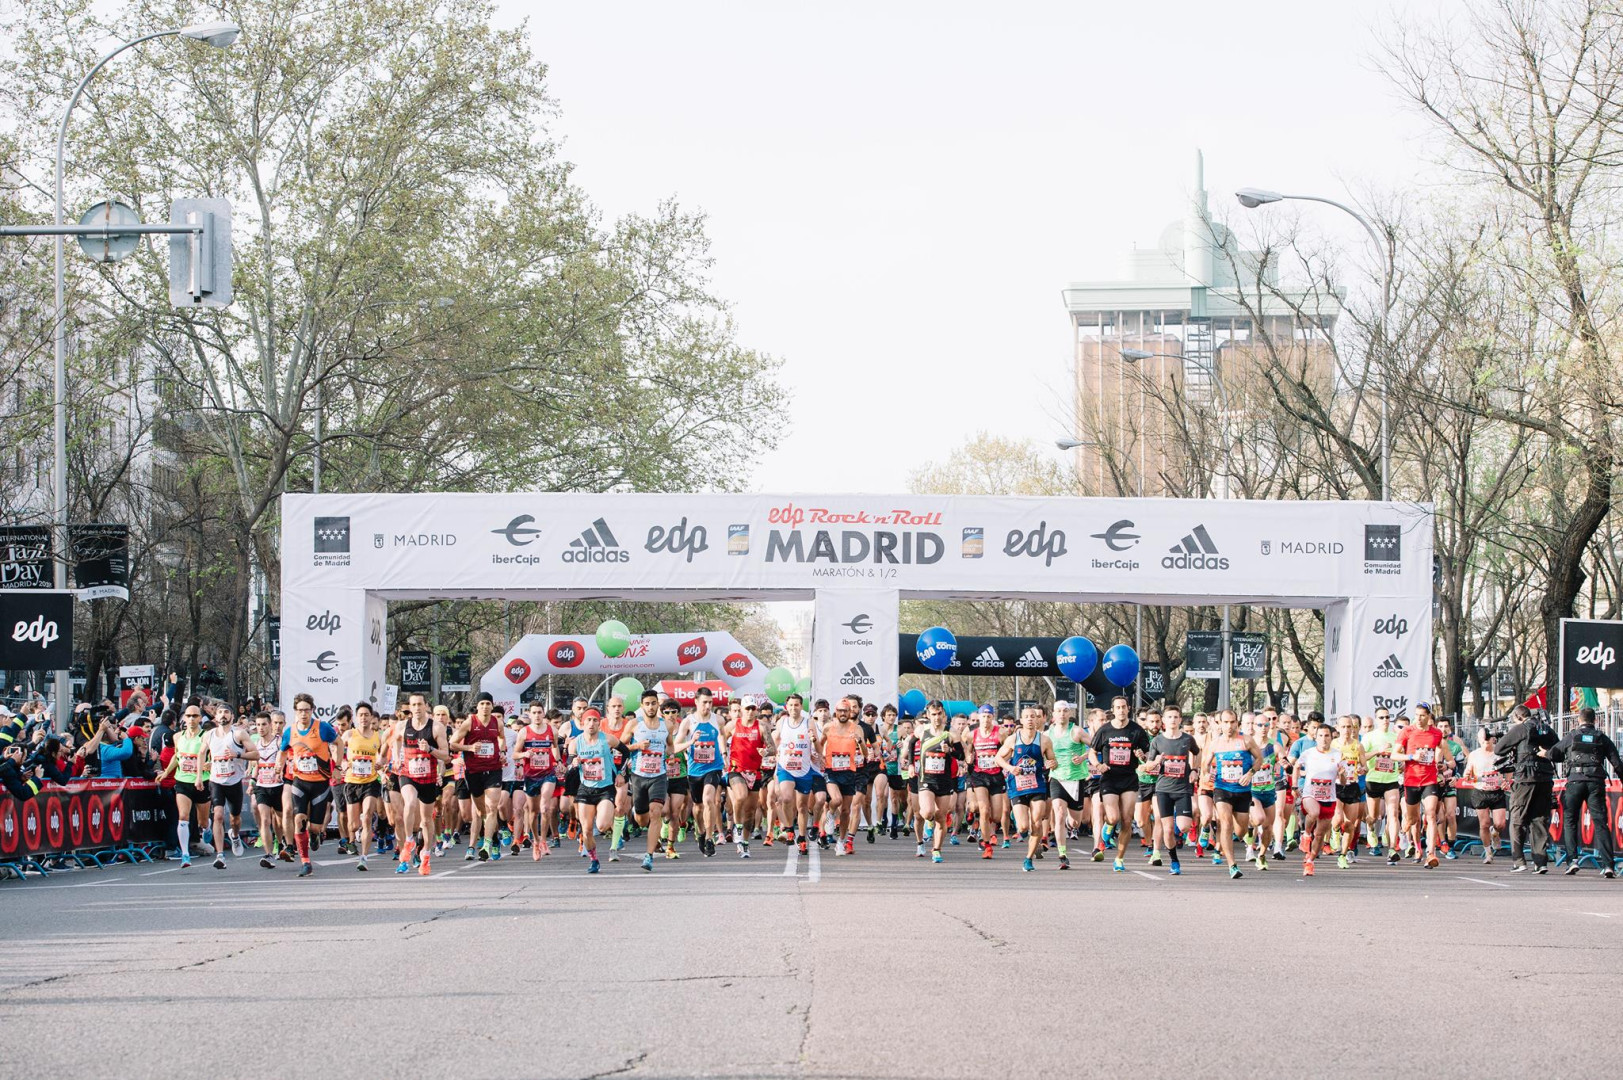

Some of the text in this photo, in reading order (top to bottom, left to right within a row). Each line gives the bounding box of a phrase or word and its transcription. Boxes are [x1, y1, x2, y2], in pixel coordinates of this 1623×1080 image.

[768, 503, 804, 529] edp
[394, 534, 456, 546] MADRID
[644, 516, 710, 564] edp
[1002, 520, 1068, 568] edp
[764, 530, 945, 564] MADRID
[1281, 542, 1344, 555] MADRID
[492, 554, 540, 566] iberCaja
[561, 546, 630, 564] adidas
[1161, 552, 1230, 570] adidas
[1091, 559, 1140, 571] iberCaja
[812, 566, 898, 578] MARATÓN & 1/2
[2, 581, 32, 589] MADRID
[306, 610, 342, 636] edp
[1373, 613, 1408, 639] edp
[12, 614, 59, 649] edp
[842, 638, 873, 647] iberCaja
[556, 648, 575, 660] edp
[684, 644, 701, 658] edp
[1238, 642, 1262, 659] Jazz
[1576, 642, 1616, 670] edp
[730, 660, 746, 670] edp
[972, 659, 1005, 668] adidas
[1016, 659, 1049, 668] adidas
[1234, 652, 1258, 668] Day
[406, 660, 428, 675] Jazz
[510, 666, 526, 676] edp
[1372, 669, 1409, 678] adidas
[307, 676, 339, 684] iberCaja
[402, 668, 424, 684] Day
[840, 676, 875, 685] adidas
[674, 688, 730, 700] ibeaja
[1372, 695, 1409, 710] Rock
